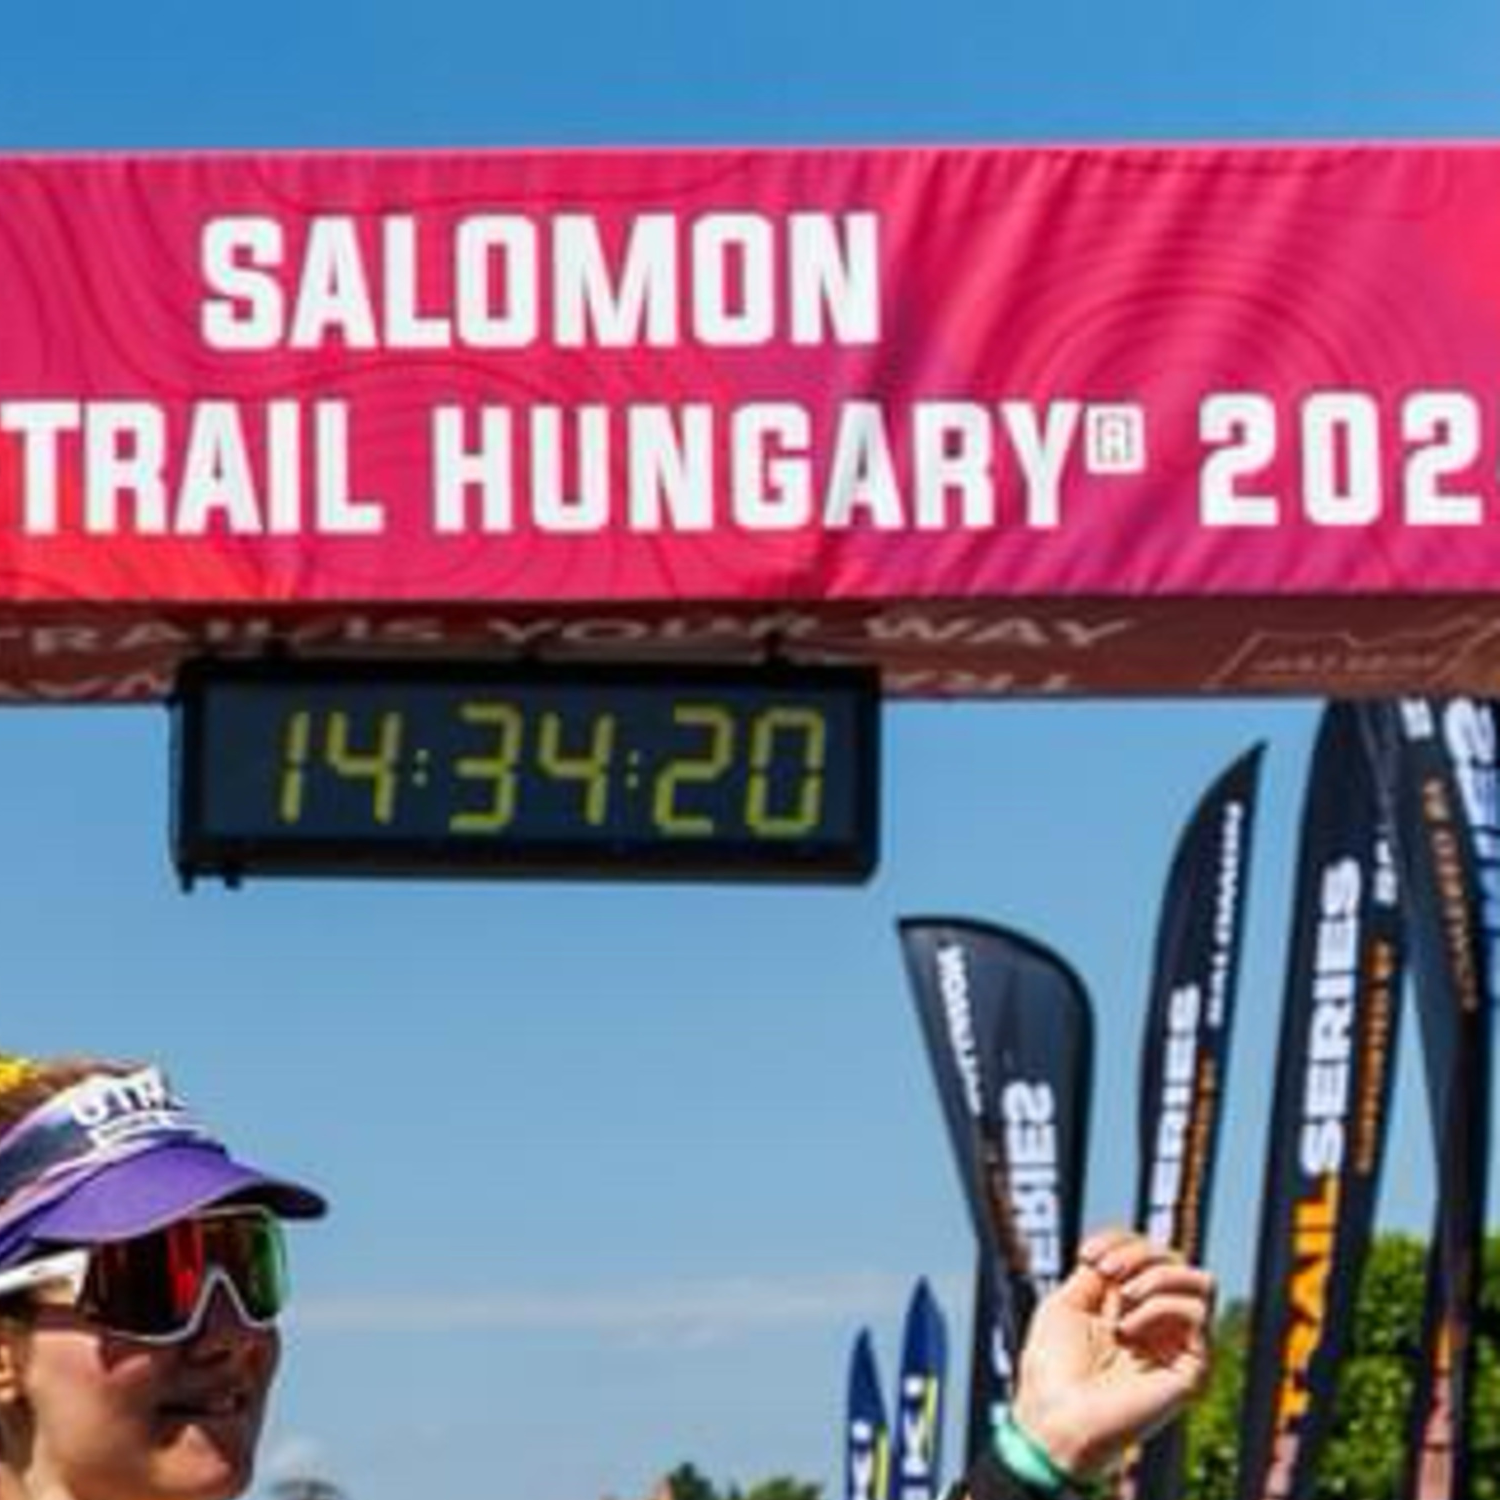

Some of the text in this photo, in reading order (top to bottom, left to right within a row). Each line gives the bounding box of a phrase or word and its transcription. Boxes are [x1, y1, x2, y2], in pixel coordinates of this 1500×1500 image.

[200, 212, 880, 350] SALOMON
[864, 615, 1136, 646] WAY
[279, 703, 826, 835] 14:34:20
[1300, 856, 1362, 1177] SERIES
